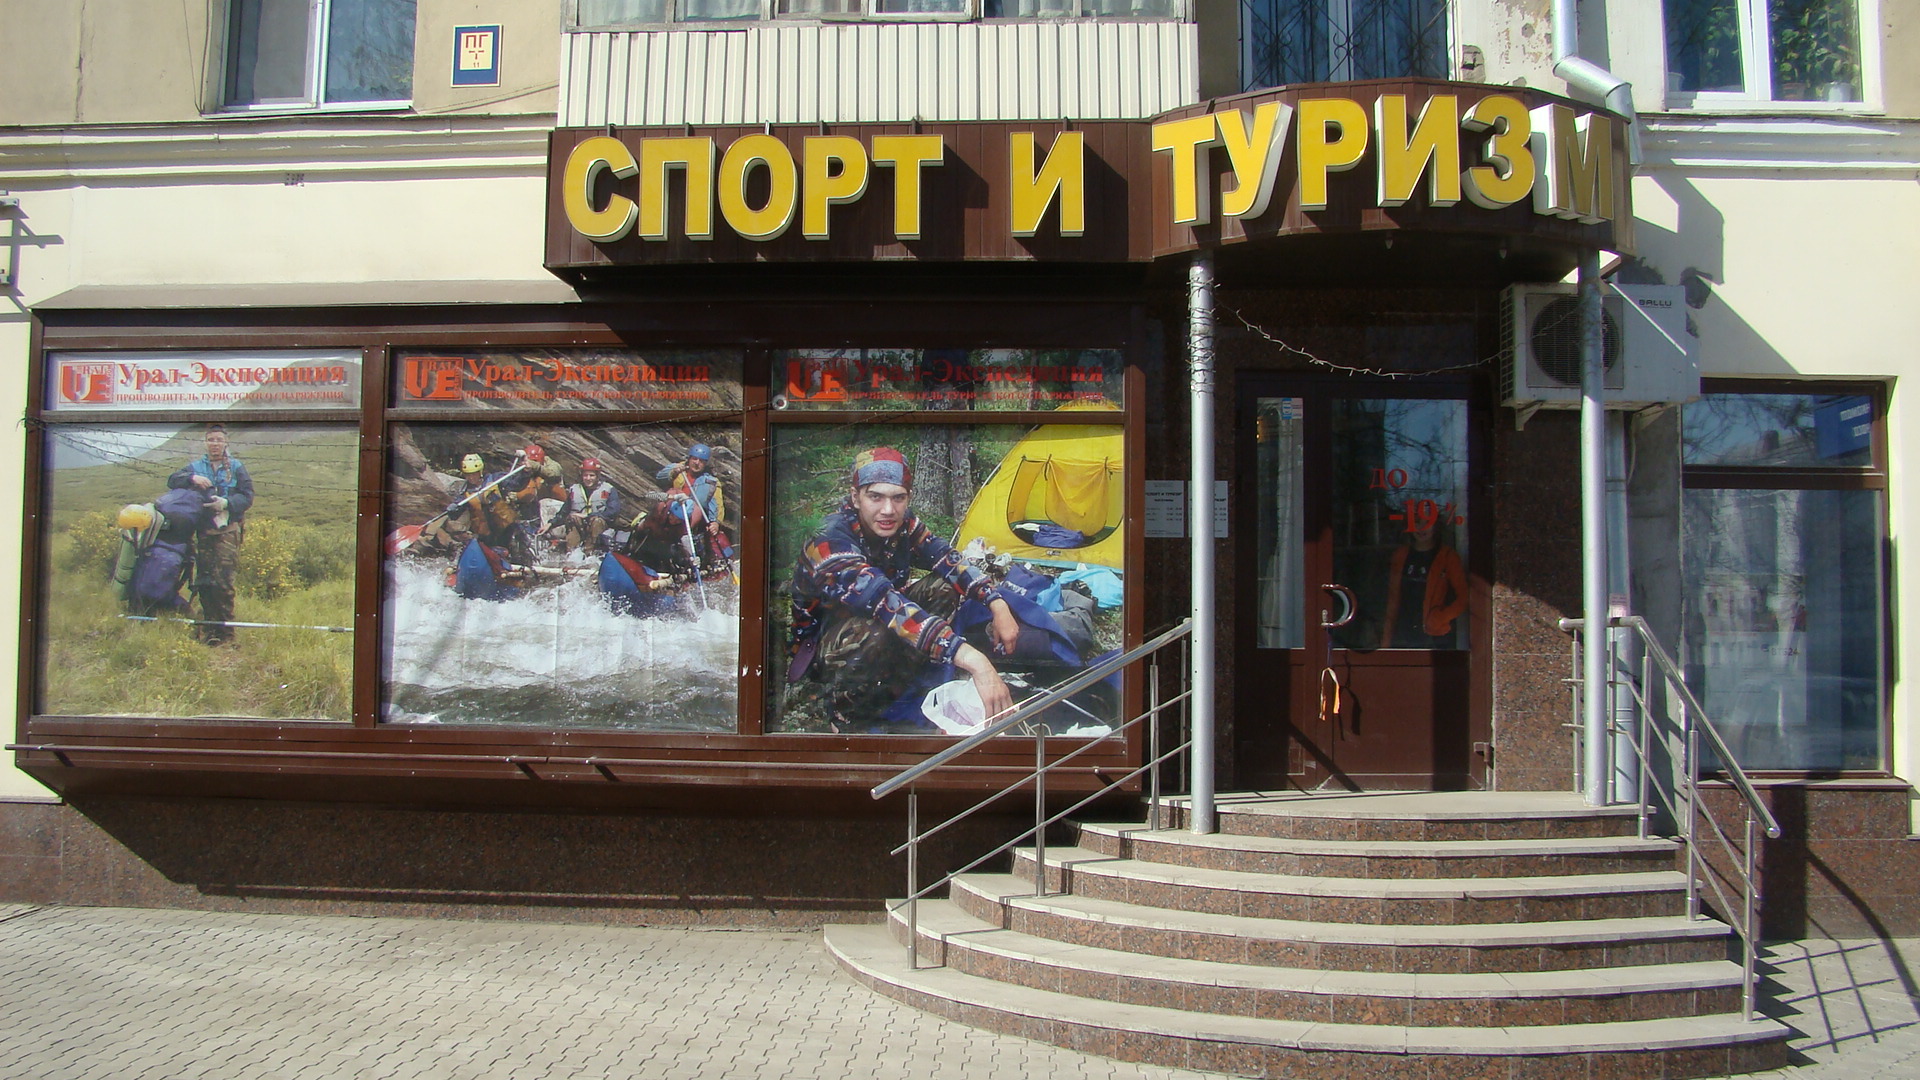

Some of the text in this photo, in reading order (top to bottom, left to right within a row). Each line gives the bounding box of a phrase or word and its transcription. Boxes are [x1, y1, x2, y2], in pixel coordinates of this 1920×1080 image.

[466, 34, 488, 48] ПГ
[563, 94, 1614, 242] СПОРТ И ТУРИЗМ
[118, 362, 345, 390] Урал-Экспедиция
[466, 358, 710, 387] Урал-Экспедиция
[116, 393, 199, 402] ПРОИЗВОДИТЕЛЬ
